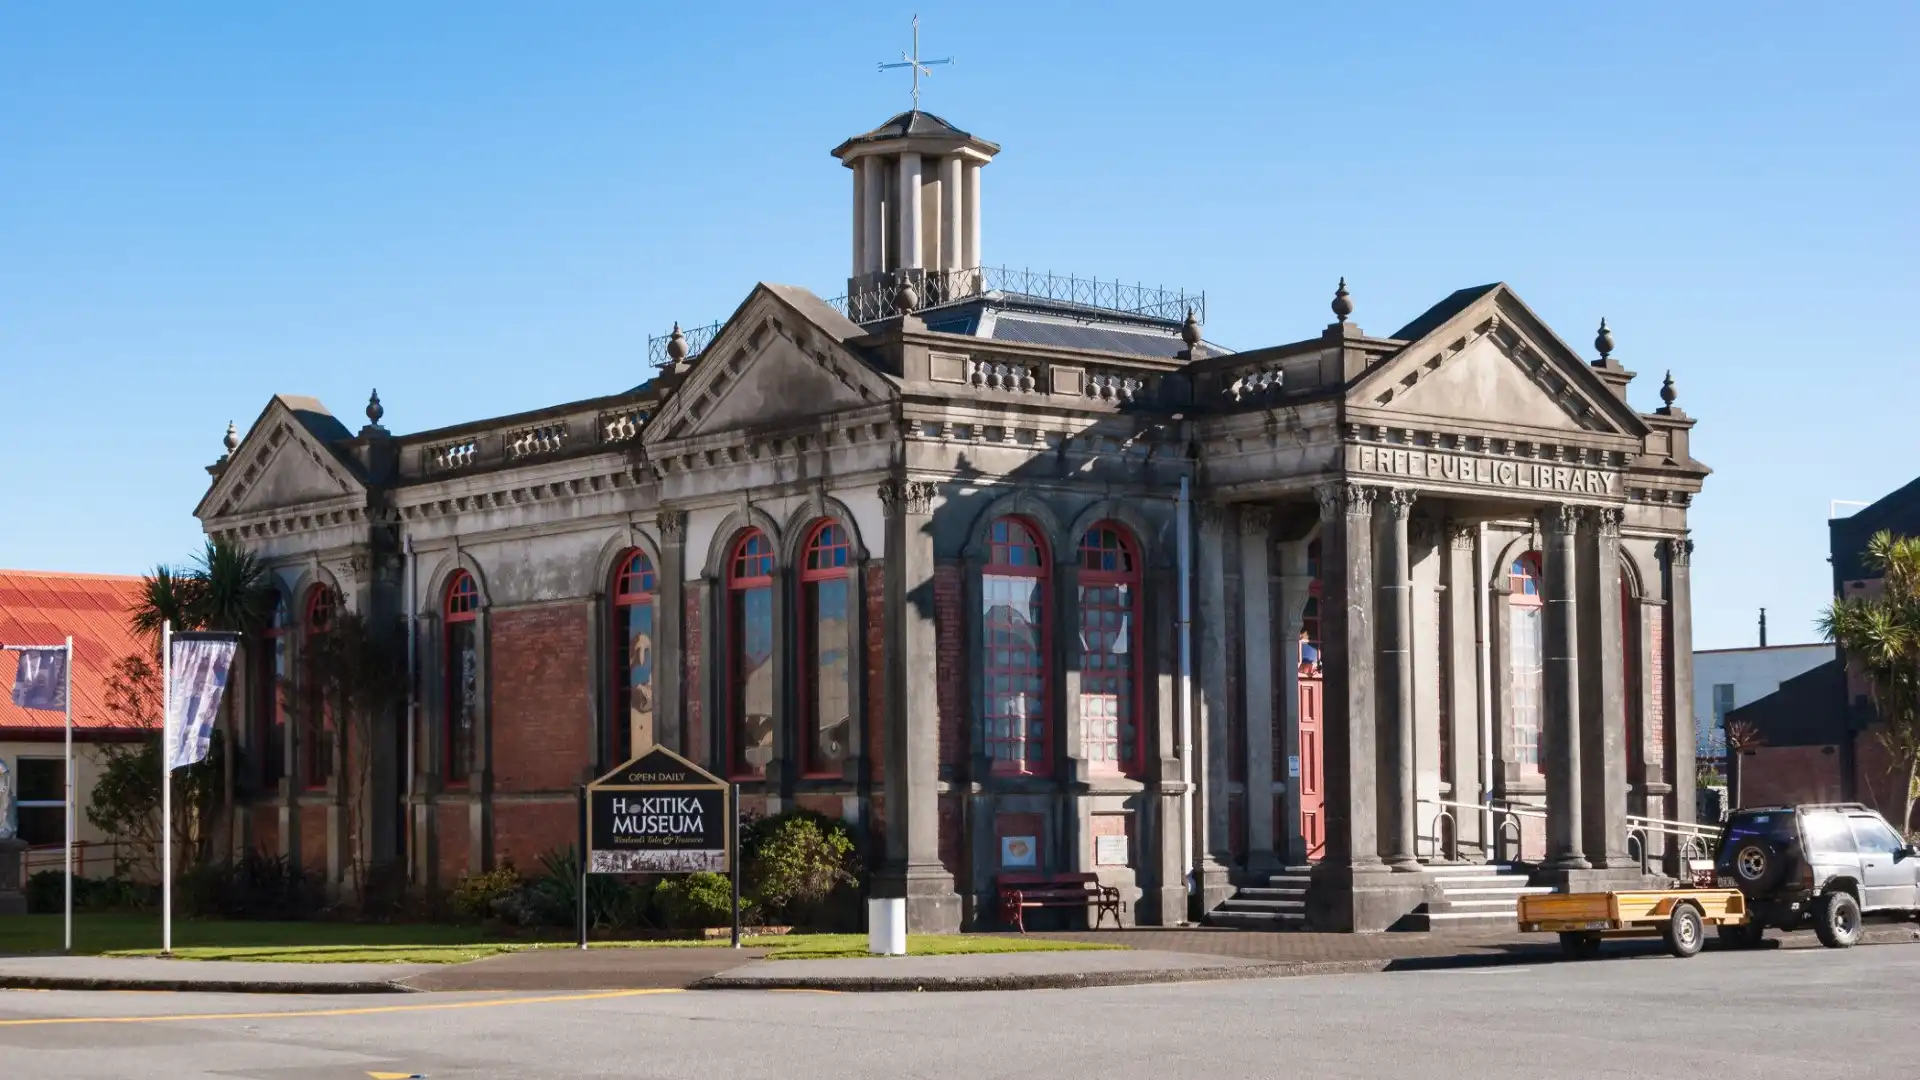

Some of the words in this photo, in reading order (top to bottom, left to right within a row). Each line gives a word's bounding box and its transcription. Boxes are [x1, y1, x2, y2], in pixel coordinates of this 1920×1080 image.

[1359, 446, 1425, 476] FREE
[1425, 452, 1513, 486] PUBLIC
[1515, 463, 1614, 494] LIBRARY
[628, 773, 656, 782] OPEN
[658, 773, 686, 782] DAILY
[612, 815, 704, 834] MUSEUM
